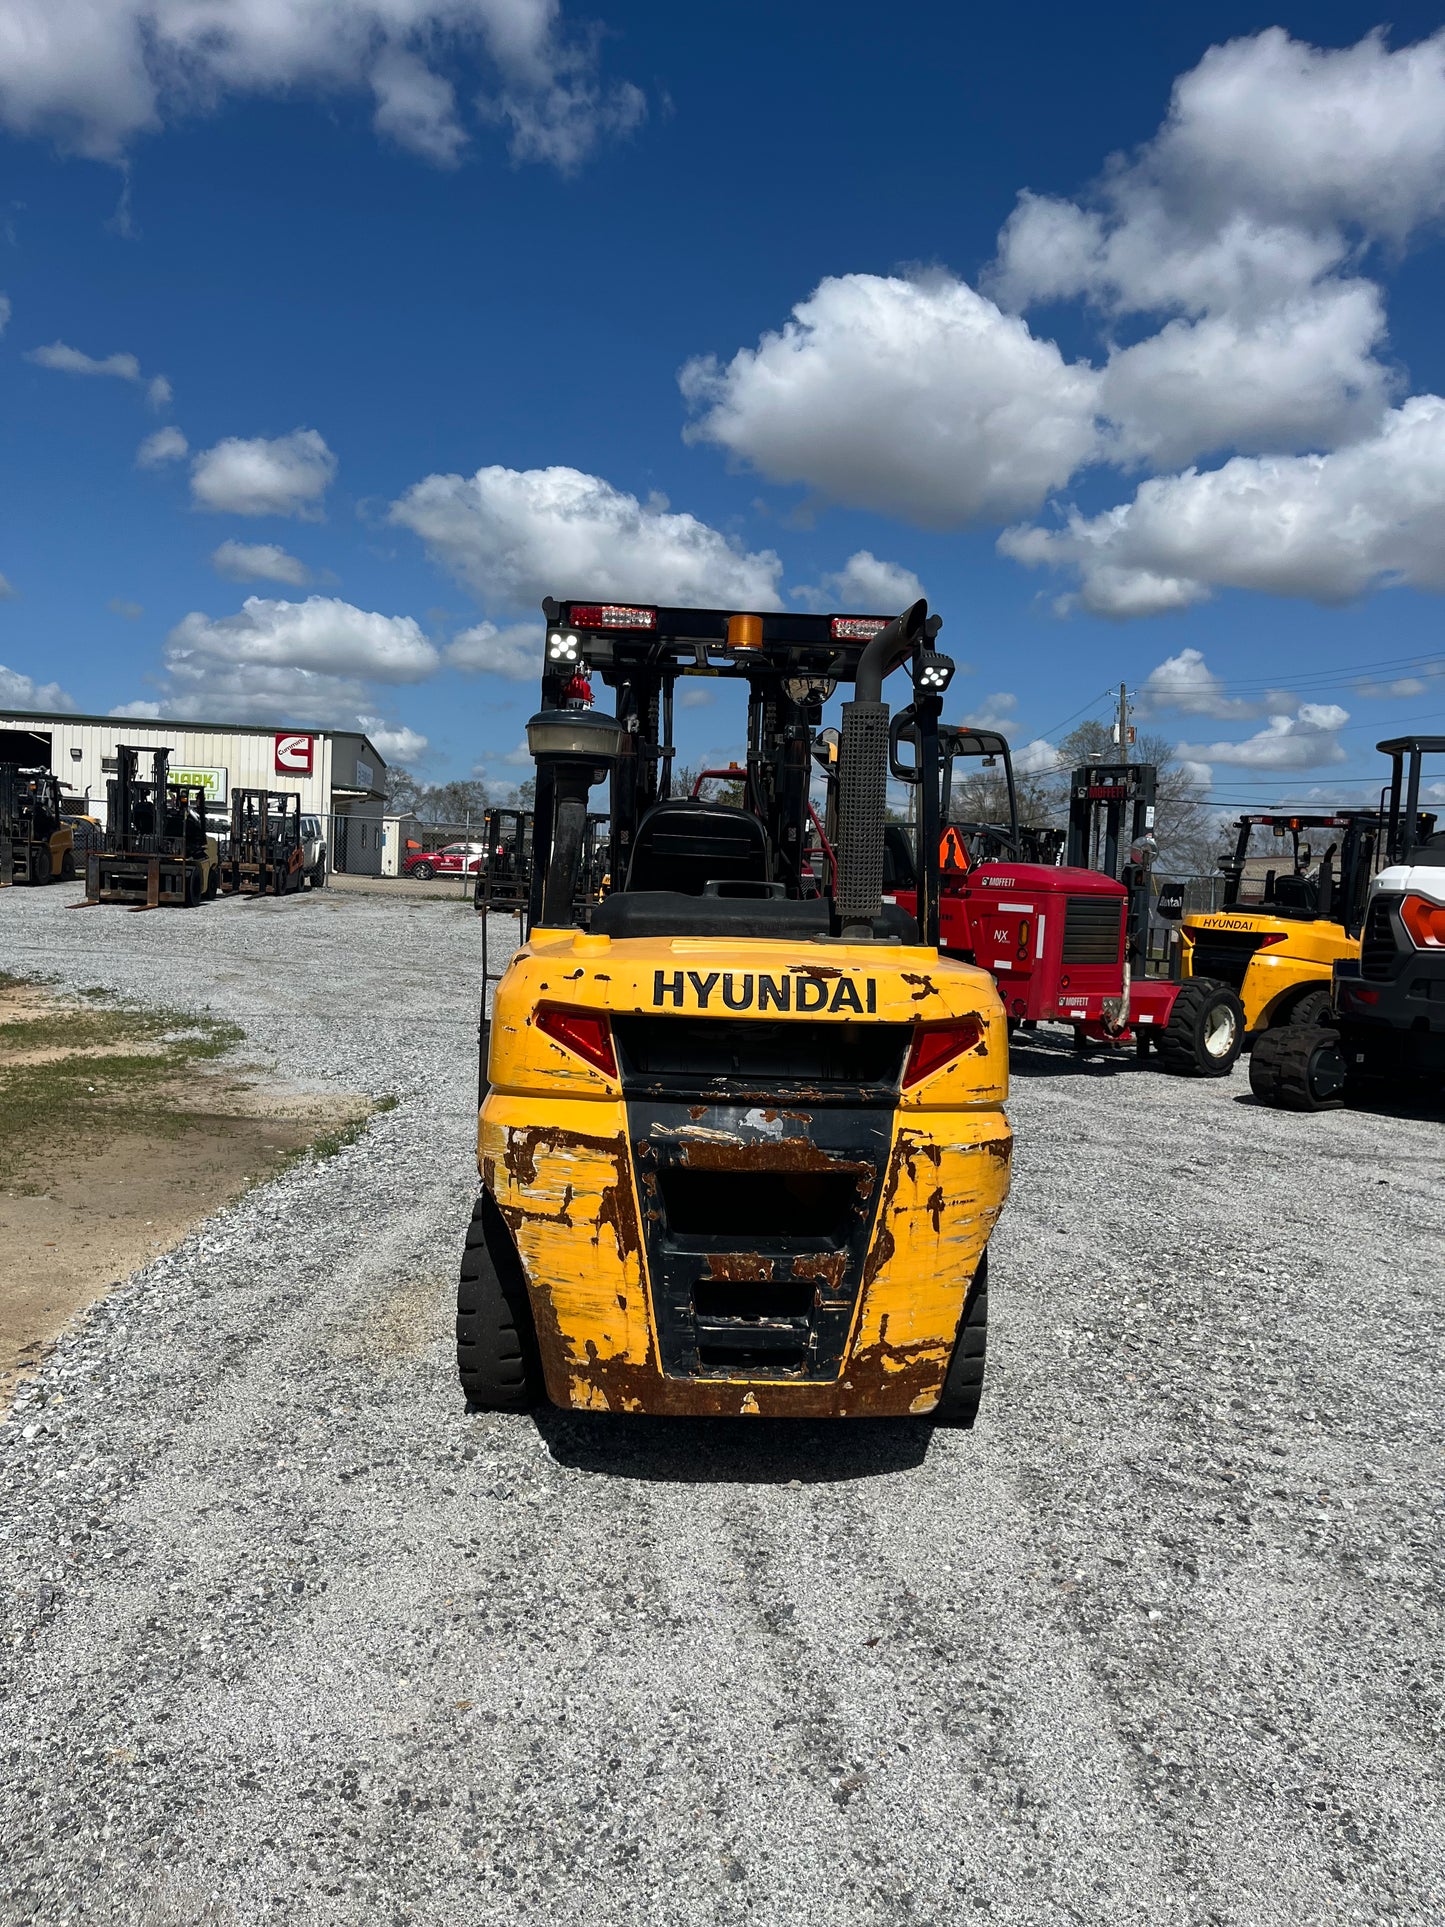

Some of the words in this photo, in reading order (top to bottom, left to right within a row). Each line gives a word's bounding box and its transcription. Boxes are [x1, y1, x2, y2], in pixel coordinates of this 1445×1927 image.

[278, 738, 306, 756] Cummins
[1089, 786, 1125, 798] MOFFETT
[989, 877, 1016, 887] MOFFETT
[1203, 919, 1254, 931] HYUNDAI
[993, 929, 1009, 943] NX
[652, 970, 877, 1014] HYUNDAI
[1065, 997, 1089, 1006] MOFFETT
